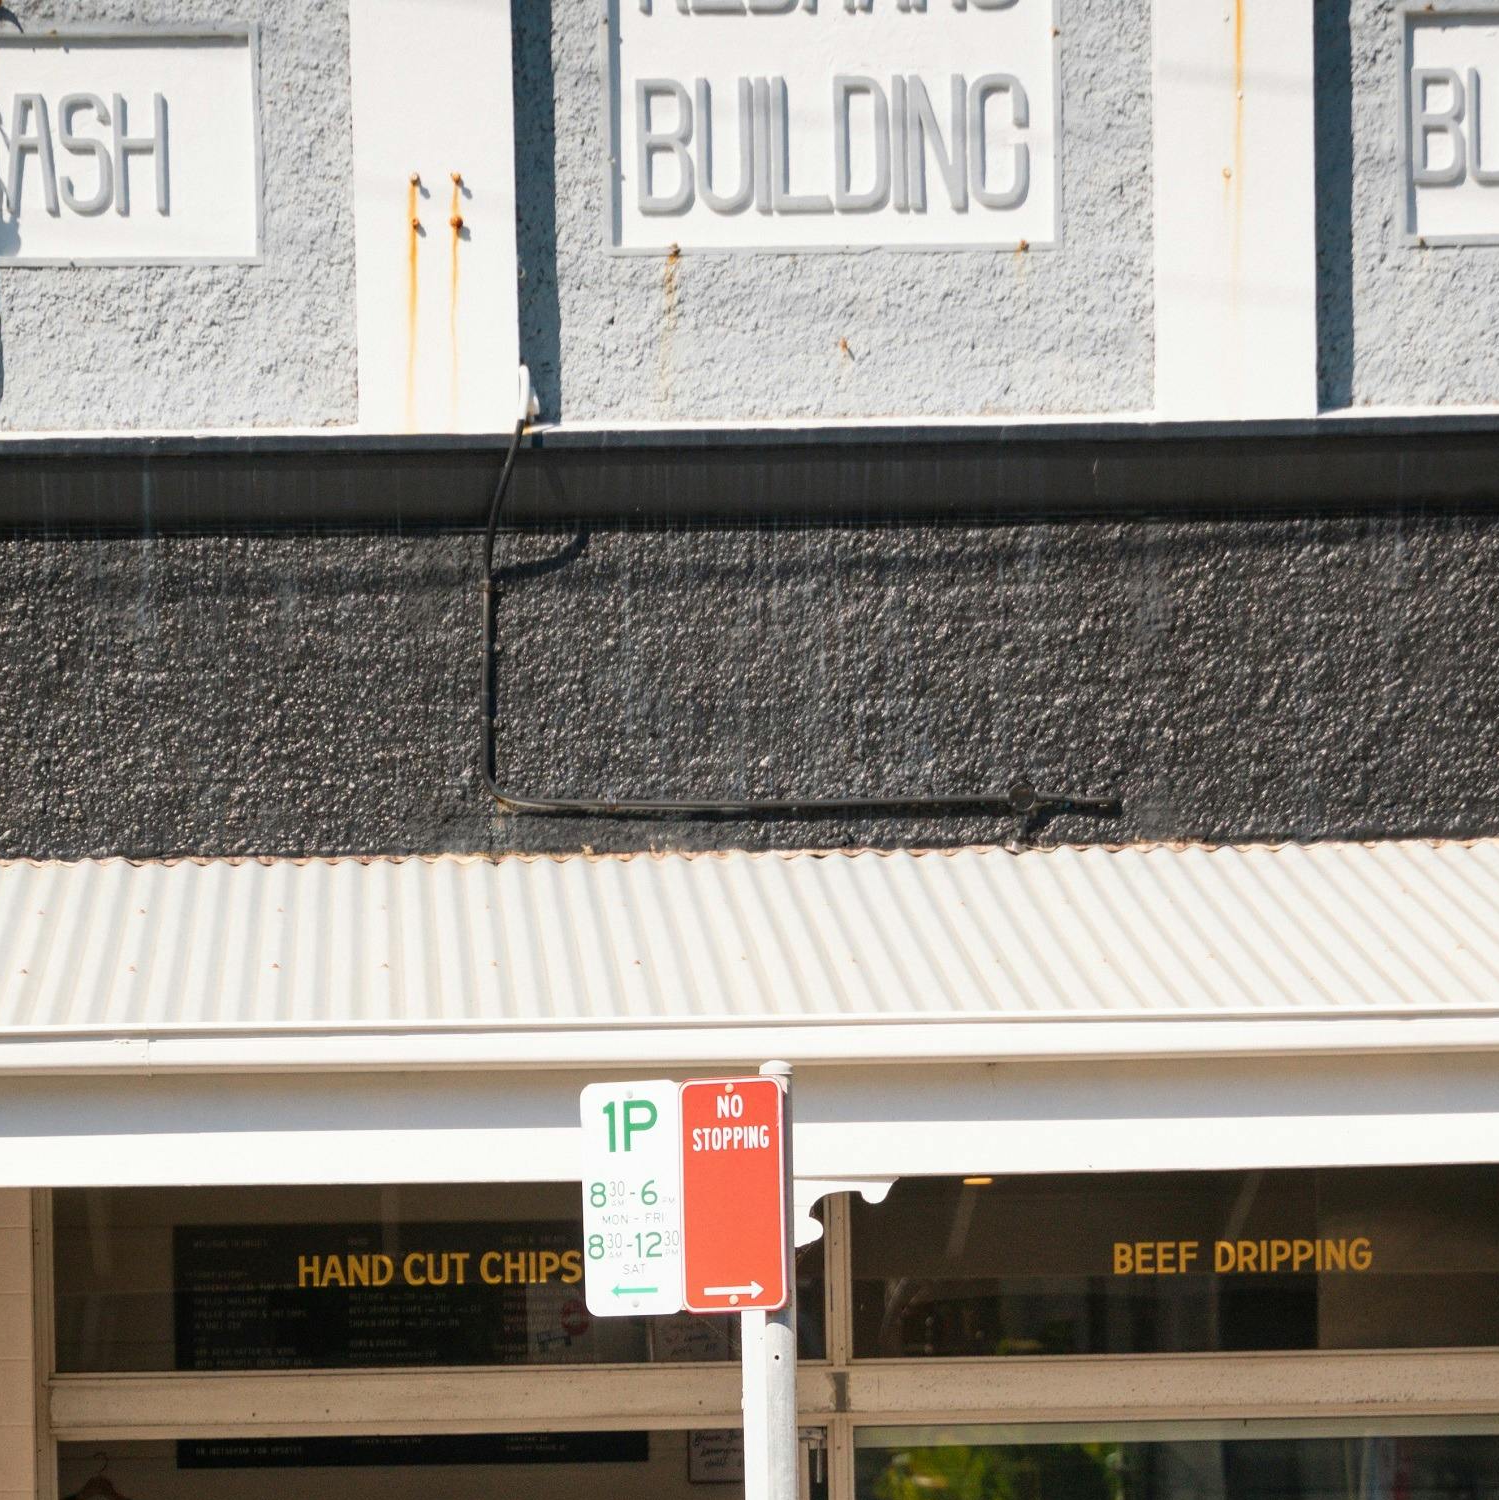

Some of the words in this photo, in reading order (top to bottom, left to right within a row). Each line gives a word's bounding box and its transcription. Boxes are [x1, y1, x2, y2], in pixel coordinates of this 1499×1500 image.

[635, 72, 1030, 216] BUILDING
[716, 1094, 744, 1119] NO
[602, 1100, 658, 1153] 1P
[692, 1125, 770, 1153] STOPPING
[601, 1214, 629, 1225] MON
[644, 1213, 665, 1224] FRI
[298, 1254, 394, 1288] HAND
[403, 1252, 471, 1286] CUT
[479, 1250, 583, 1285] CHIPS
[622, 1263, 646, 1275] SAT
[1113, 1241, 1199, 1275] BEEF
[1214, 1237, 1373, 1273] DRIPPING
